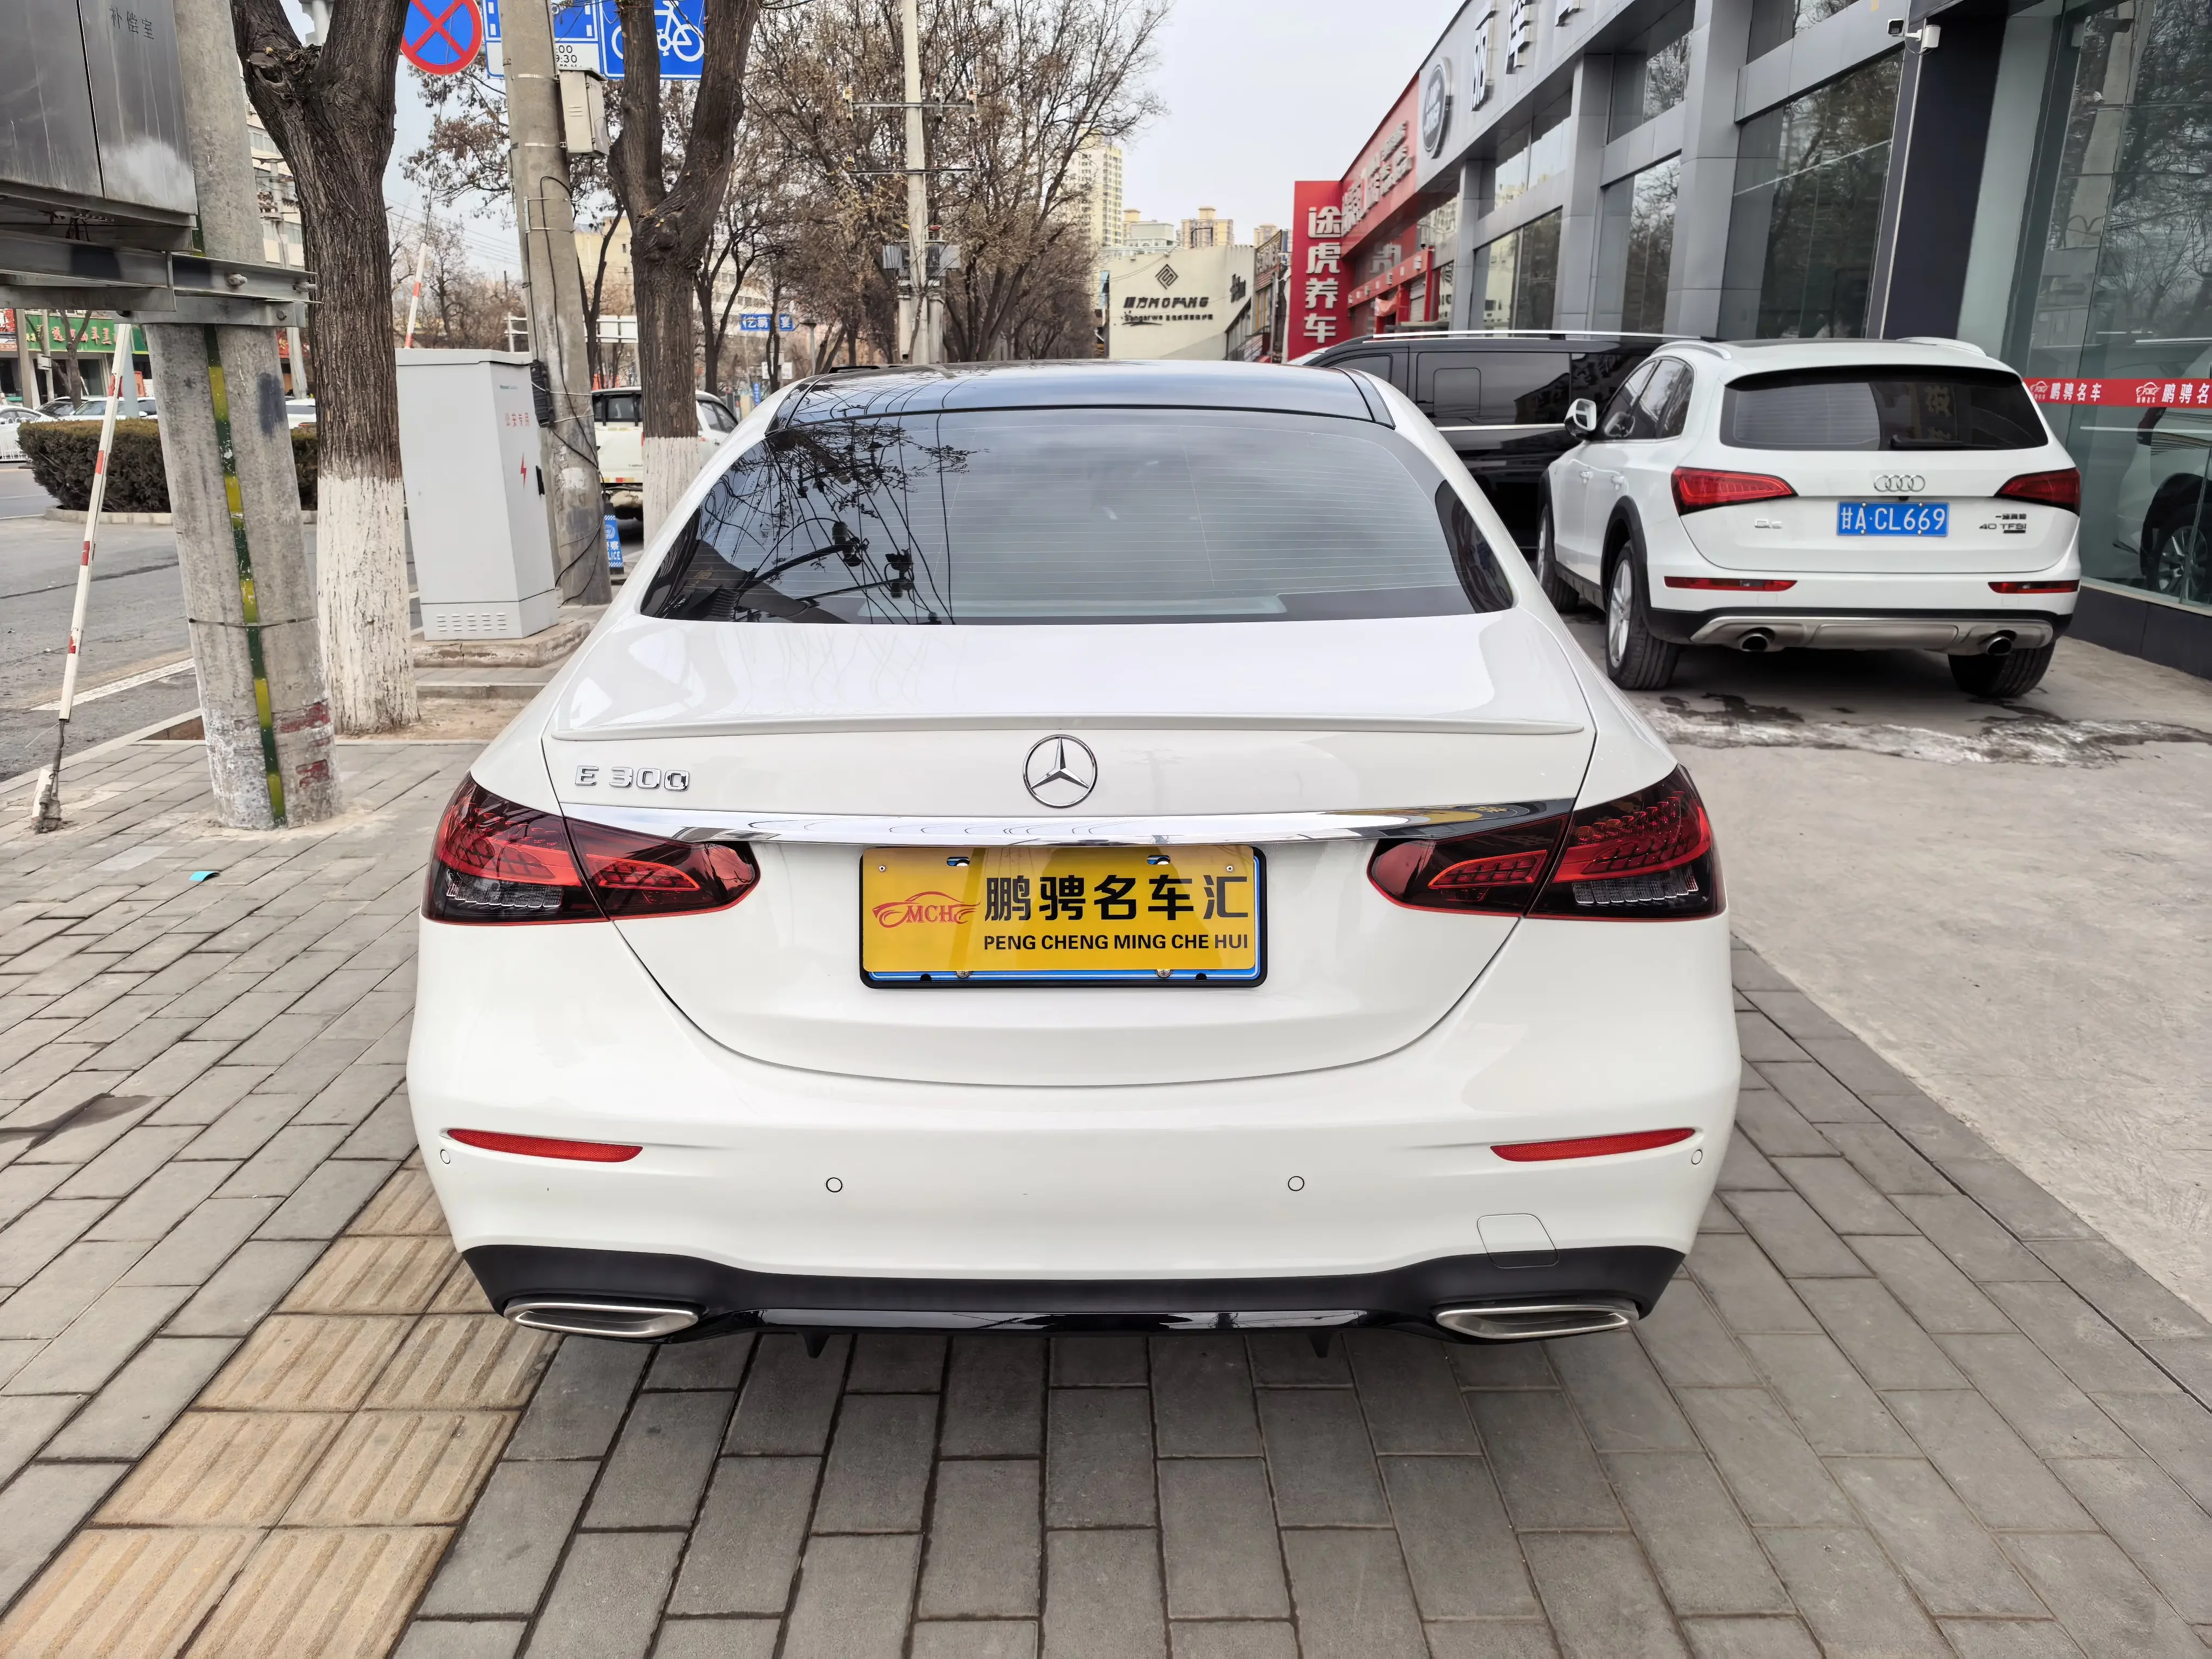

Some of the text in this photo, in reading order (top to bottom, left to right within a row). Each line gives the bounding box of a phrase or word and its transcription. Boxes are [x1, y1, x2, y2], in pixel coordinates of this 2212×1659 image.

[555, 45, 572, 53] :00
[1303, 206, 1342, 344] 途虎养车
[2161, 382, 2212, 404] 鹏骋名
[608, 551, 621, 561] LICE
[575, 765, 690, 792] E 300
[984, 874, 1249, 922] 鹏骋名车汇
[984, 934, 1248, 950] PENG CHENG MING CHE HUI
